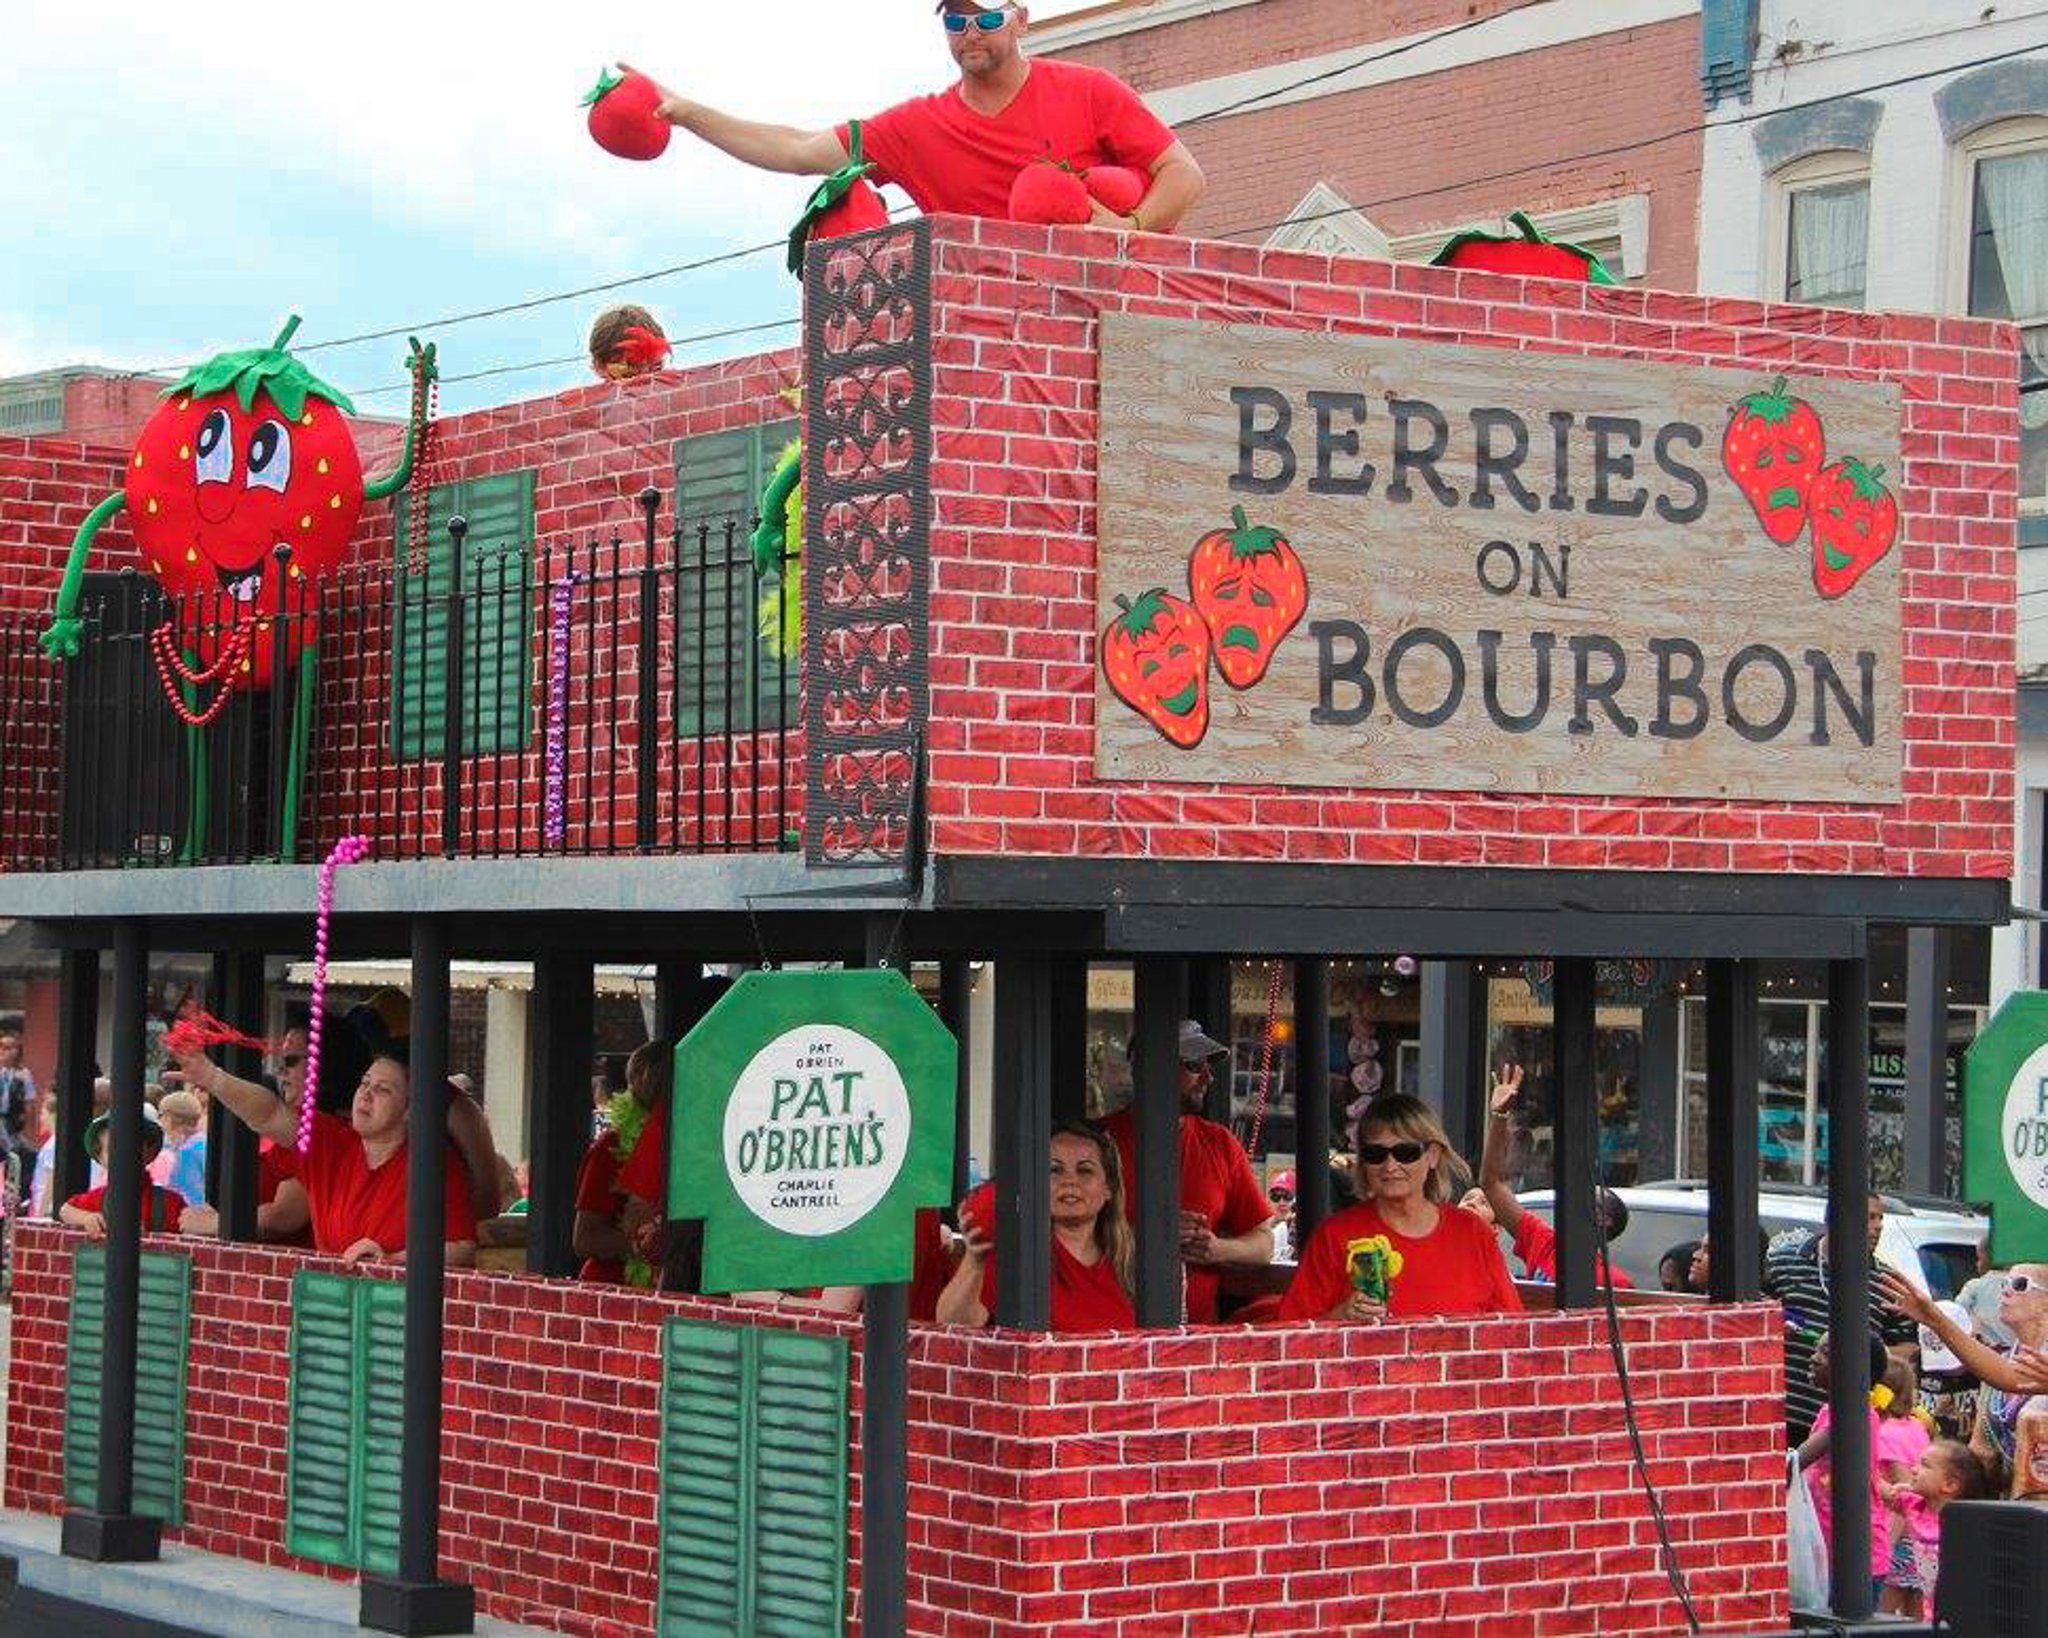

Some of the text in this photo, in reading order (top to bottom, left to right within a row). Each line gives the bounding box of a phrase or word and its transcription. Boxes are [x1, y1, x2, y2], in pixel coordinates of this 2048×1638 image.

[1229, 386, 1708, 523] BERRIES
[1477, 540, 1571, 598] ON
[1309, 619, 1876, 746] BOURBON
[809, 1043, 833, 1054] PAT
[771, 1071, 863, 1121] PAT
[739, 1111, 884, 1174] O'BRIEN'S
[771, 1195, 841, 1208] CANTRELL
[777, 1179, 836, 1192] CHARLIE
